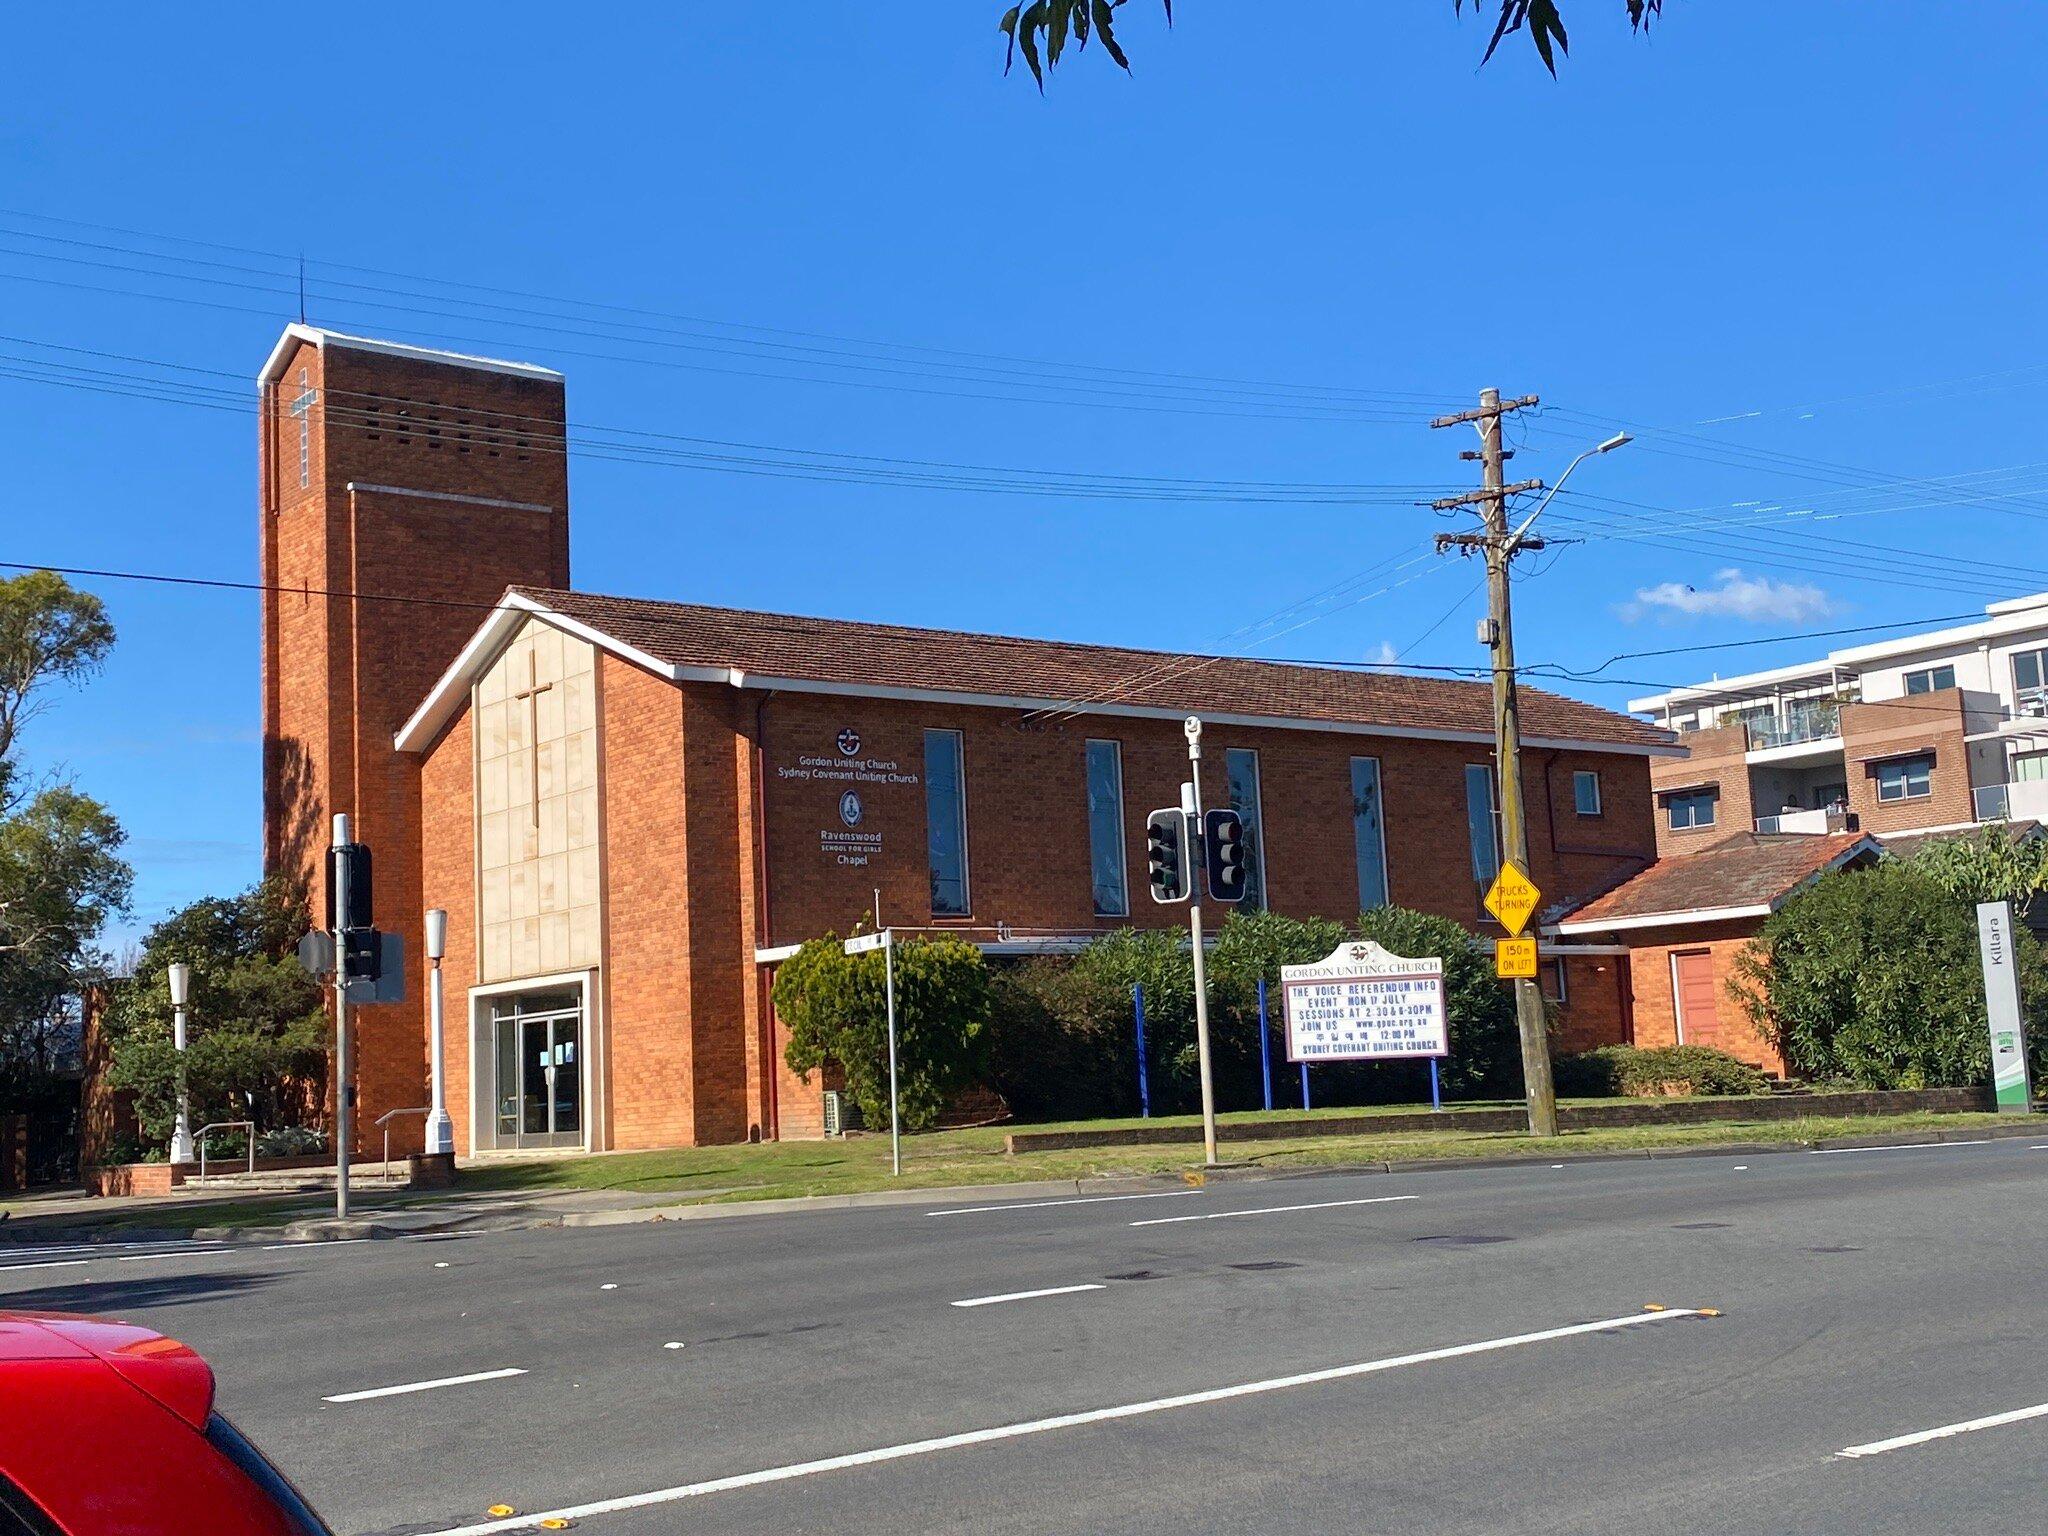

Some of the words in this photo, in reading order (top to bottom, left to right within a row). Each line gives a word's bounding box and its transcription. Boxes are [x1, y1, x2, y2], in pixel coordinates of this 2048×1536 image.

[800, 756, 832, 767] Gordon
[834, 758, 865, 770] Uniting
[867, 759, 897, 770] Church
[778, 767, 810, 780] Sydney
[812, 769, 853, 780] Covenant
[856, 770, 886, 783] Uniting
[888, 773, 918, 784] Church
[821, 830, 882, 842] Ravenswood
[837, 855, 868, 866] Chapel
[1496, 885, 1528, 897] TRUCKS
[1494, 900, 1531, 911] TURNING
[1990, 918, 2003, 965] Killara
[1285, 967, 1334, 978] GORDON
[1337, 963, 1386, 976] UNITING
[1389, 961, 1438, 973] CHURCH
[1503, 960, 1514, 970] ON
[1518, 959, 1532, 970] LEFT
[1293, 986, 1309, 997] THE
[1315, 985, 1342, 996] VOICE
[1349, 982, 1411, 995] REFERENDUM
[1414, 980, 1436, 992] INFO
[1308, 998, 1337, 1008] EVENT
[1348, 996, 1366, 1006] MON
[1370, 996, 1378, 1005] 17
[1382, 994, 1407, 1005] JULY
[1299, 1009, 1345, 1020] SESSIONS
[1349, 1008, 1360, 1018] AT
[1301, 1021, 1321, 1031] JOIN
[1326, 1020, 1337, 1031] US
[1404, 1029, 1415, 1039] PM
[1303, 1043, 1330, 1054] SYDNEY
[1333, 1042, 1370, 1053] COVENANT
[1373, 1041, 1403, 1052] UNITING
[1406, 1040, 1438, 1051] CHURCH
